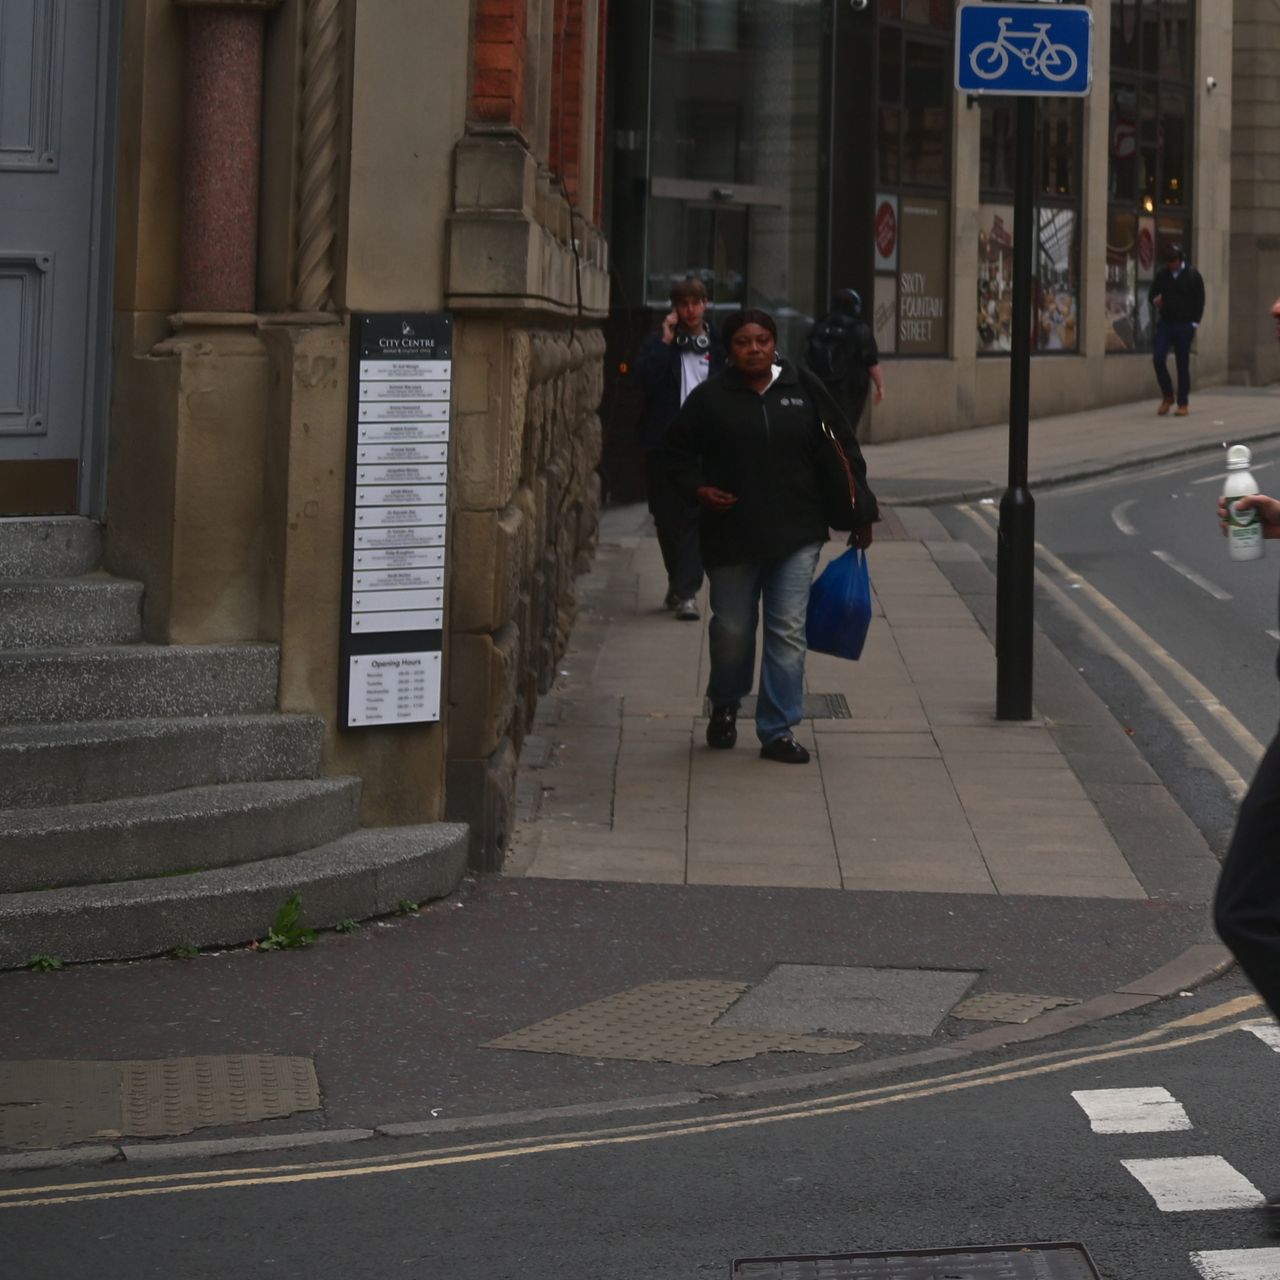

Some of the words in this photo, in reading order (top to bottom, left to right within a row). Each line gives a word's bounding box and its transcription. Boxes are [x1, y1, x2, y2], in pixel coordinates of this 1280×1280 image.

[900, 272, 926, 294] SIXTY
[900, 297, 944, 319] FOUNTAIN
[900, 319, 933, 342] STREET
[371, 659, 401, 669] Opening
[401, 658, 421, 667] Hours
